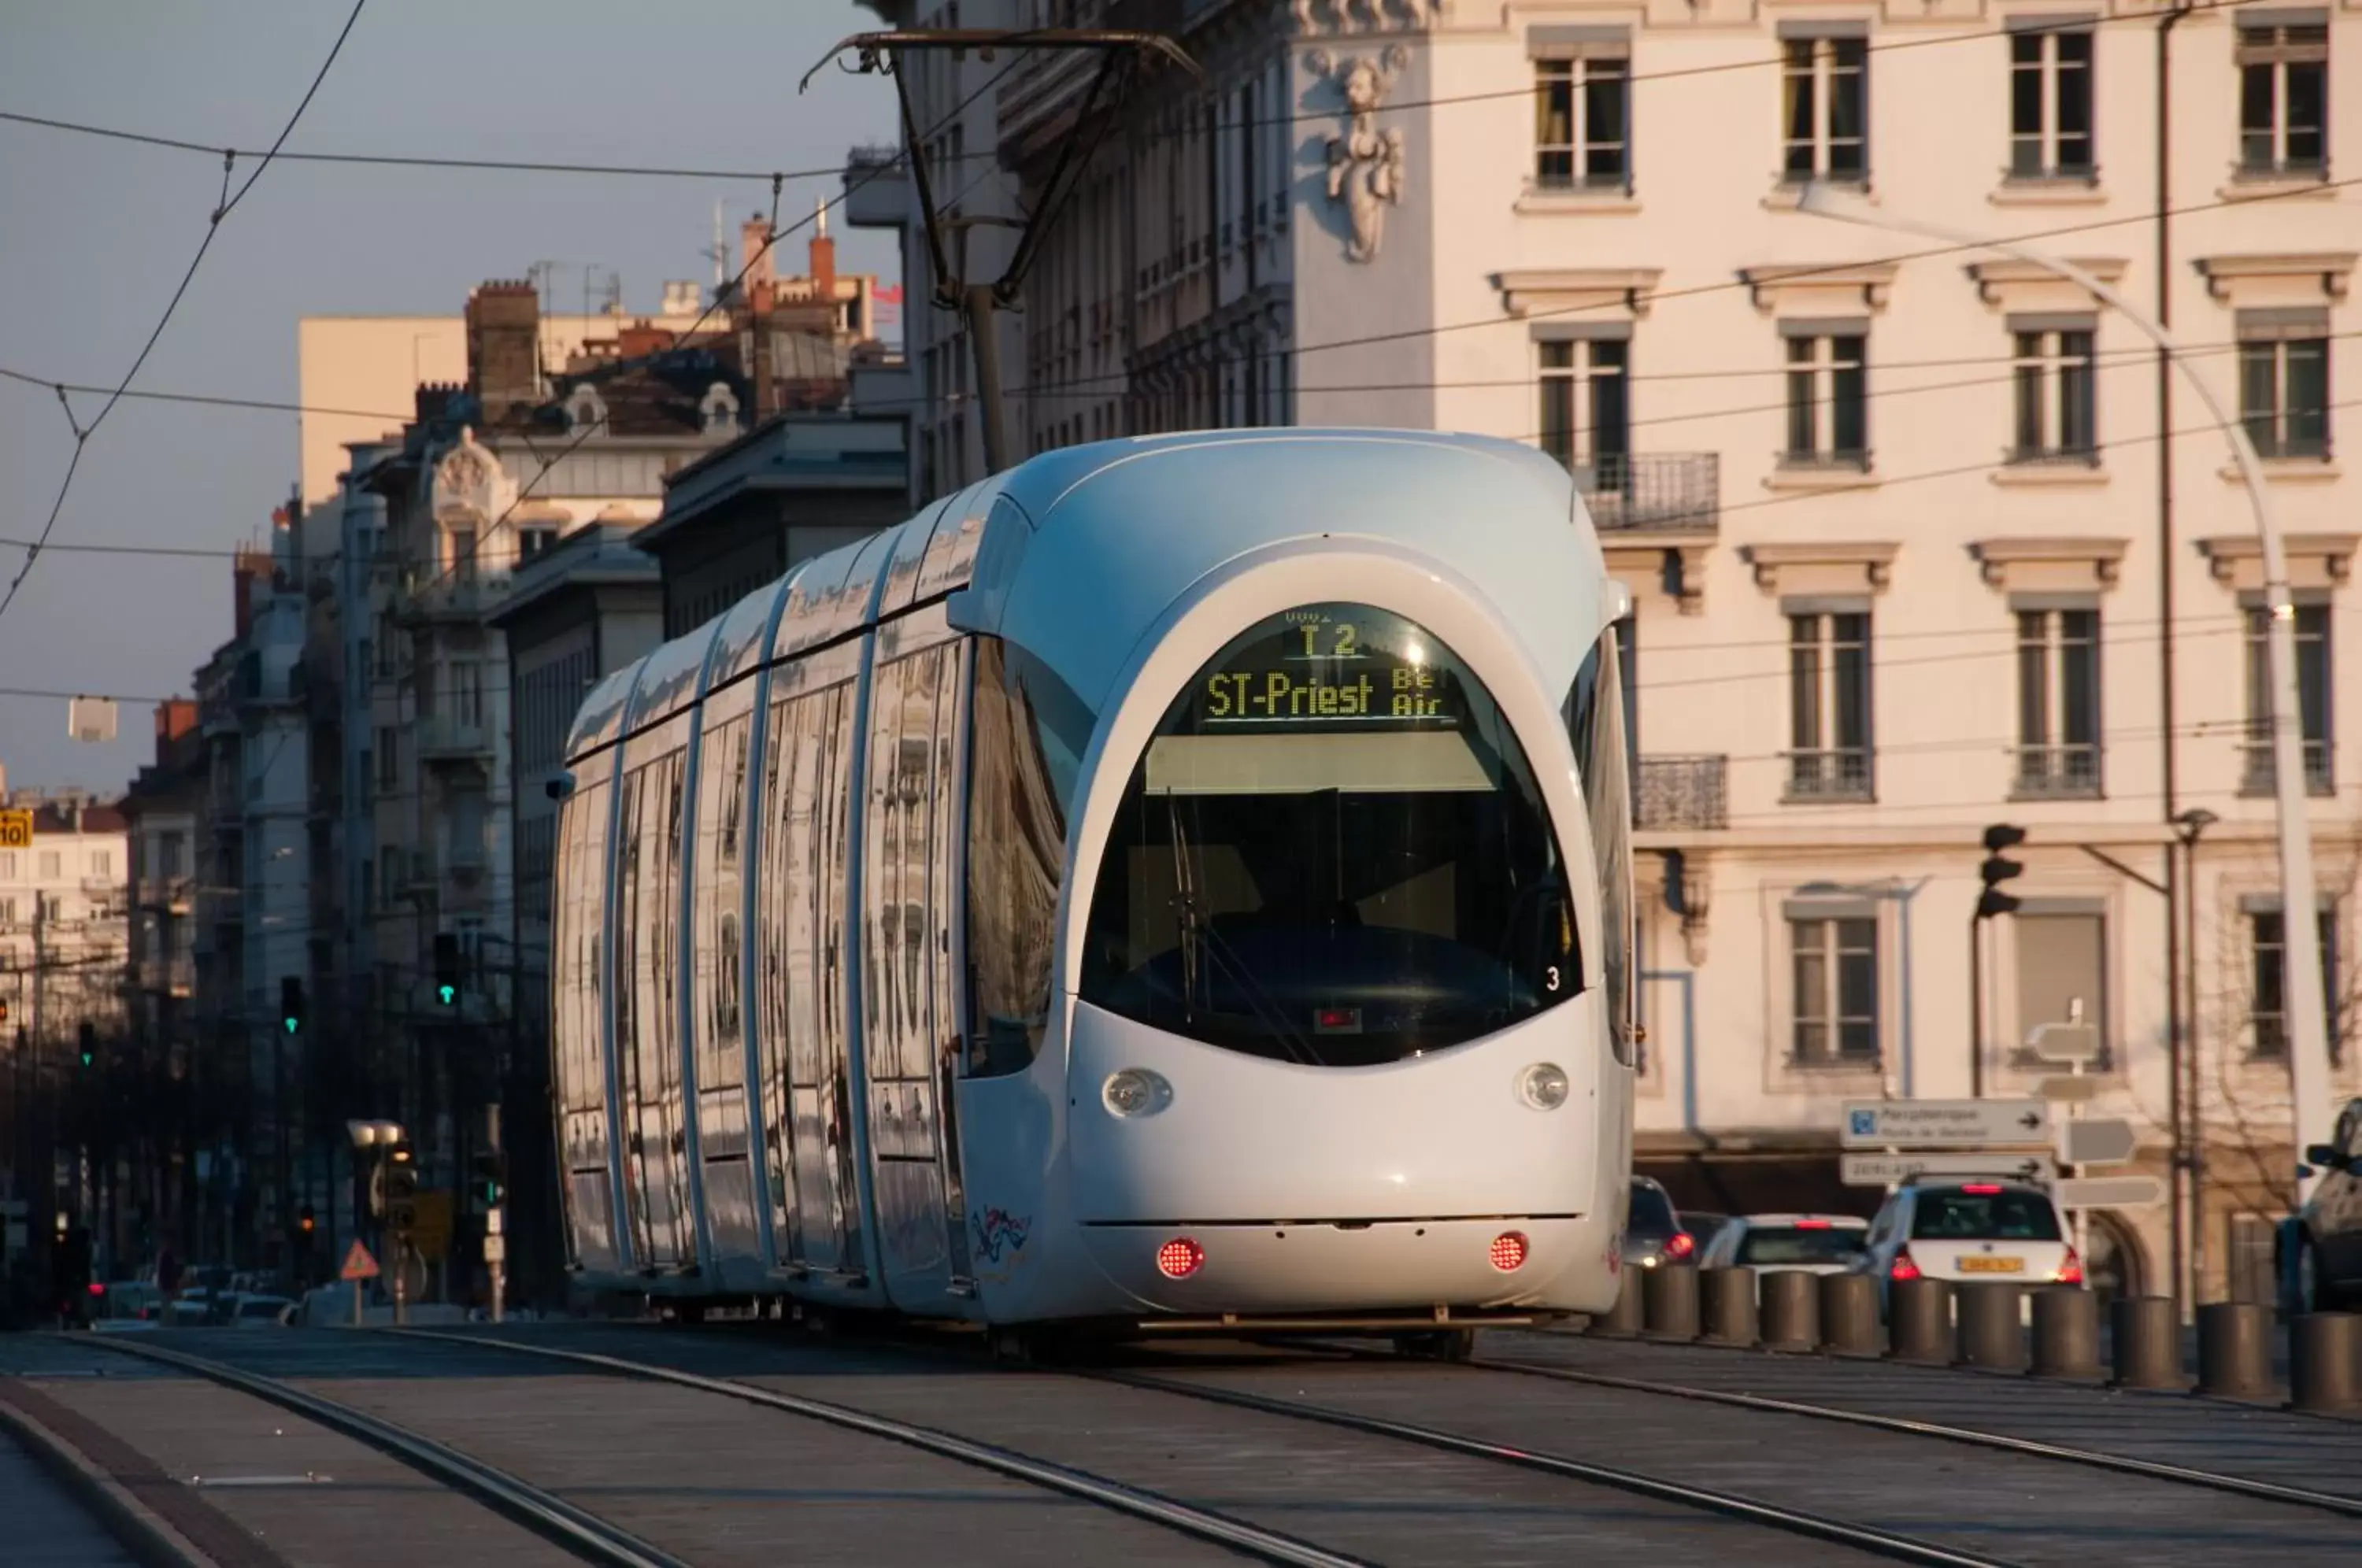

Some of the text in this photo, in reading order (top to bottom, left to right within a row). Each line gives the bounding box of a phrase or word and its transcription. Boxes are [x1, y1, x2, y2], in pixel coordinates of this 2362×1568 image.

[1300, 623, 1355, 656] T 2
[1208, 671, 1374, 716] ST-Priest
[1392, 693, 1443, 716] Air
[1546, 965, 1560, 992] 3
